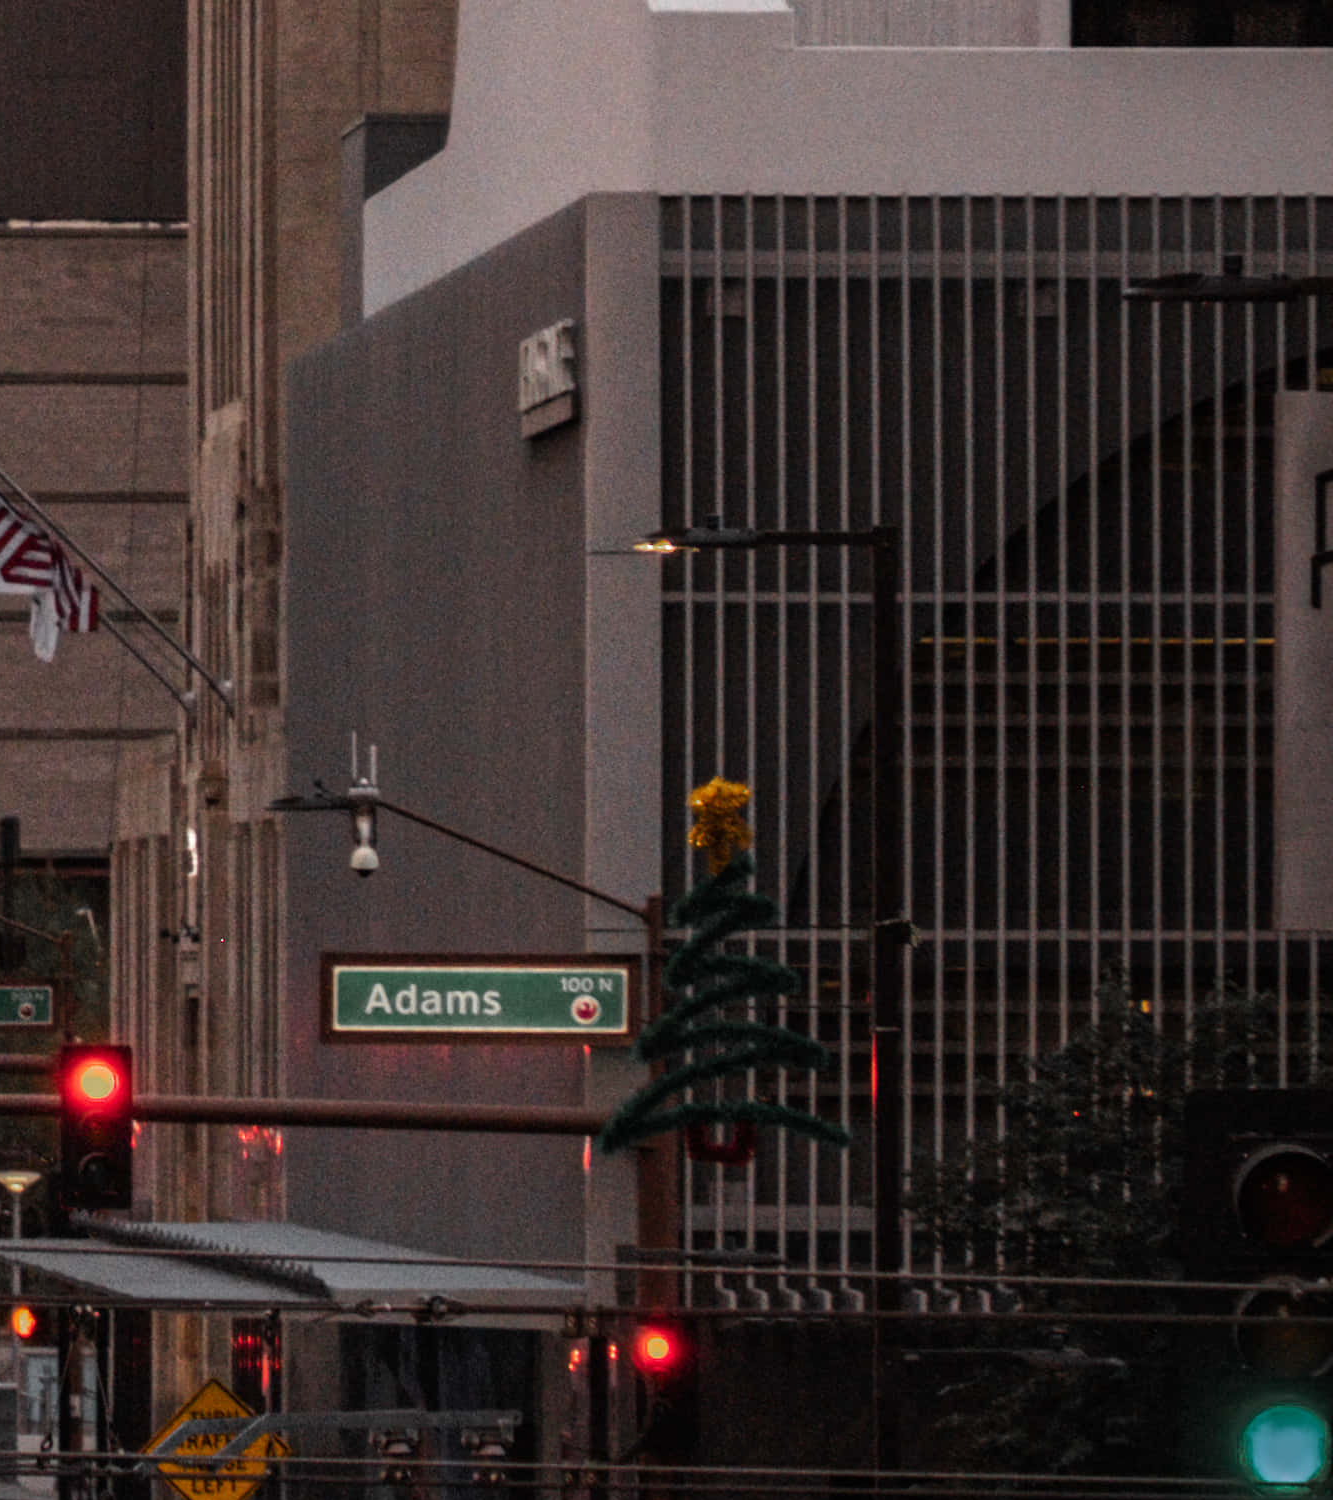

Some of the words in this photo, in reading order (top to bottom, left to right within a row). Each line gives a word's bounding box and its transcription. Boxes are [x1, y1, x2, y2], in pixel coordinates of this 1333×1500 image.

[364, 982, 502, 1016] Adams
[559, 976, 593, 993] 100
[598, 977, 613, 993] N
[191, 1477, 237, 1494] LEFT
